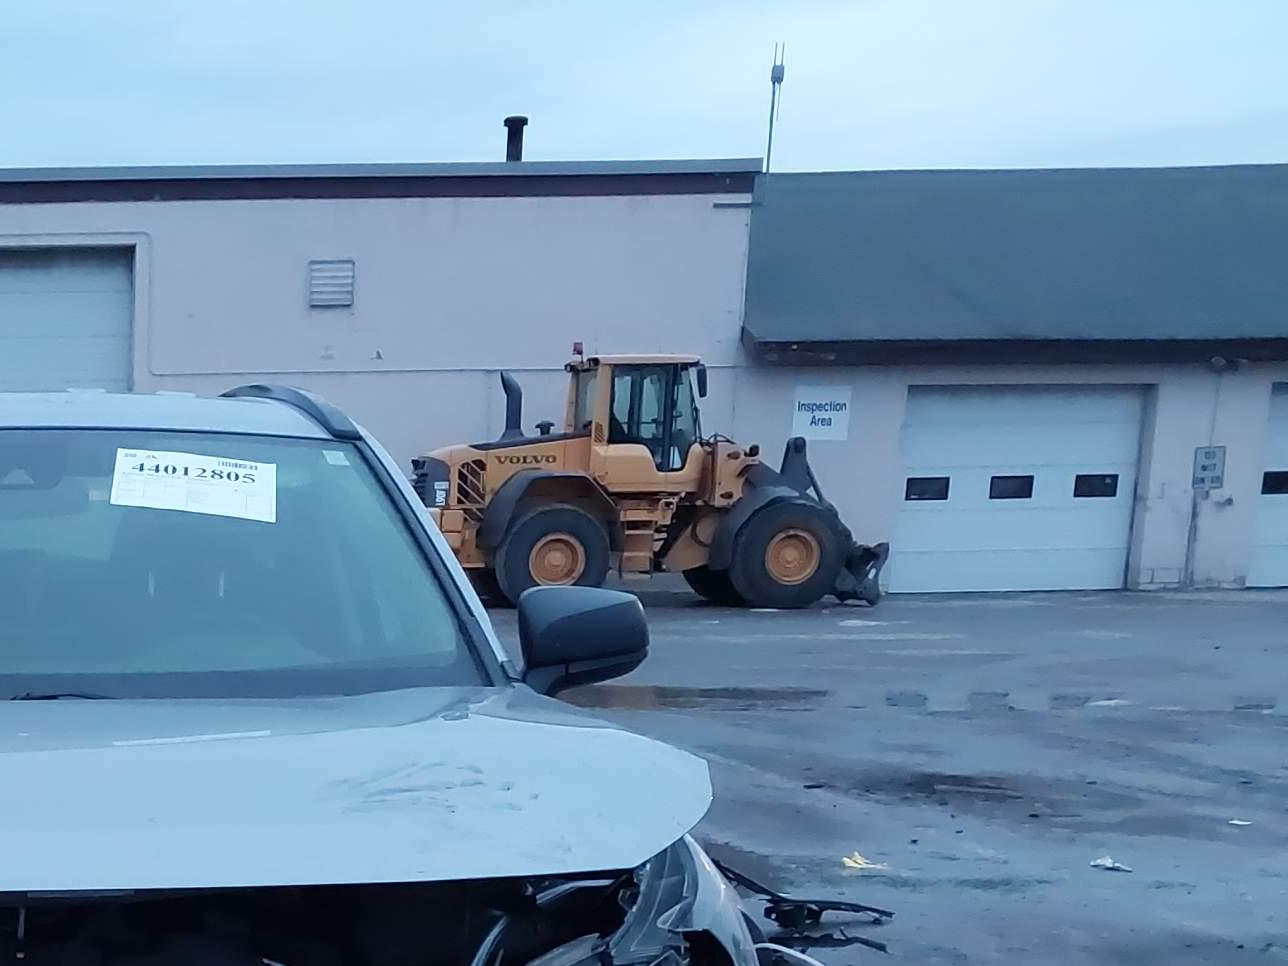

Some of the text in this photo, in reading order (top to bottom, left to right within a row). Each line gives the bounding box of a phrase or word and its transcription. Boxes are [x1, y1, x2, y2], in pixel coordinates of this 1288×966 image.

[797, 400, 847, 414] Inspection
[809, 415, 833, 427] Area
[495, 454, 558, 465] VOLVO
[131, 461, 257, 484] 44012805
